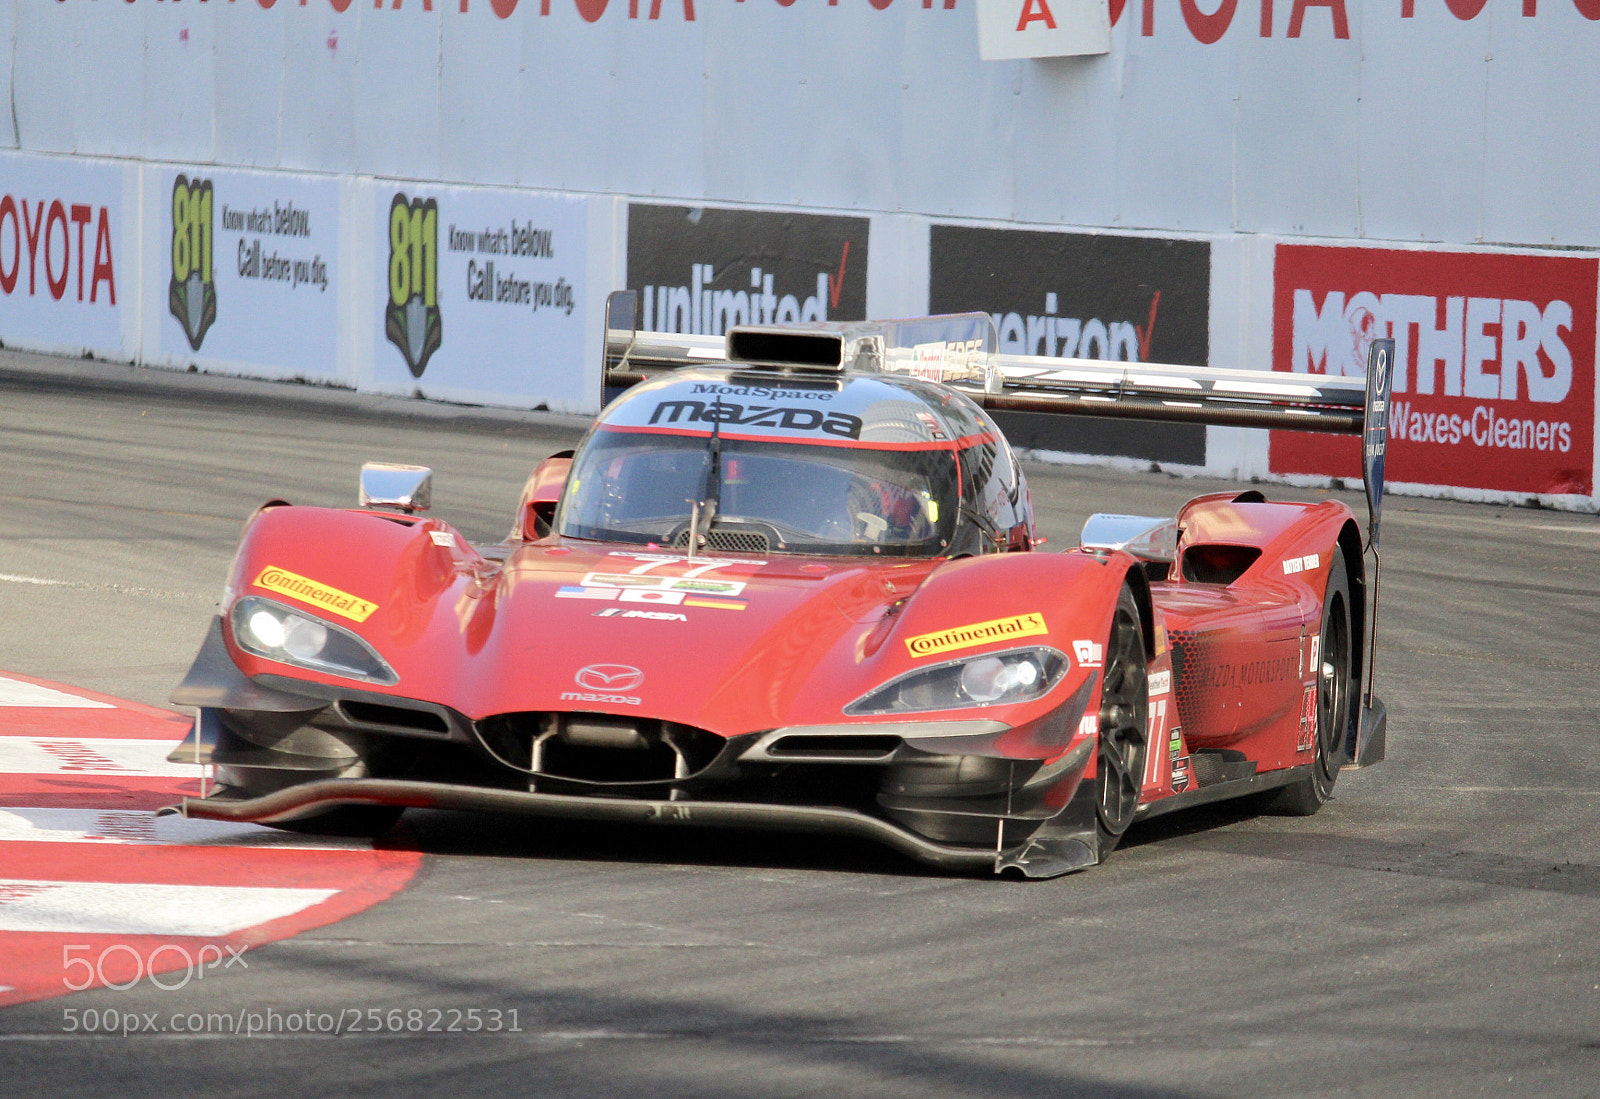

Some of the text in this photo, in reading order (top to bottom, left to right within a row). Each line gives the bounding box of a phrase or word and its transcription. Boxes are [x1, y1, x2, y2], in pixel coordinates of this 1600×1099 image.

[172, 174, 214, 284] 811
[222, 199, 311, 238] Know what's below.
[449, 218, 553, 258] Know what's below.
[0, 193, 116, 306] OYOTA
[238, 237, 260, 278] Call
[262, 250, 290, 281] before
[293, 259, 310, 290] you
[388, 193, 438, 307] 811
[468, 259, 493, 301] Call
[496, 271, 531, 304] before
[533, 282, 553, 312] you
[1292, 288, 1573, 404] MOTHERS
[691, 383, 833, 402] ModSpace
[260, 569, 358, 613] Continental
[629, 556, 734, 579] 77
[910, 618, 1024, 654] Continental
[1142, 699, 1167, 786] 77
